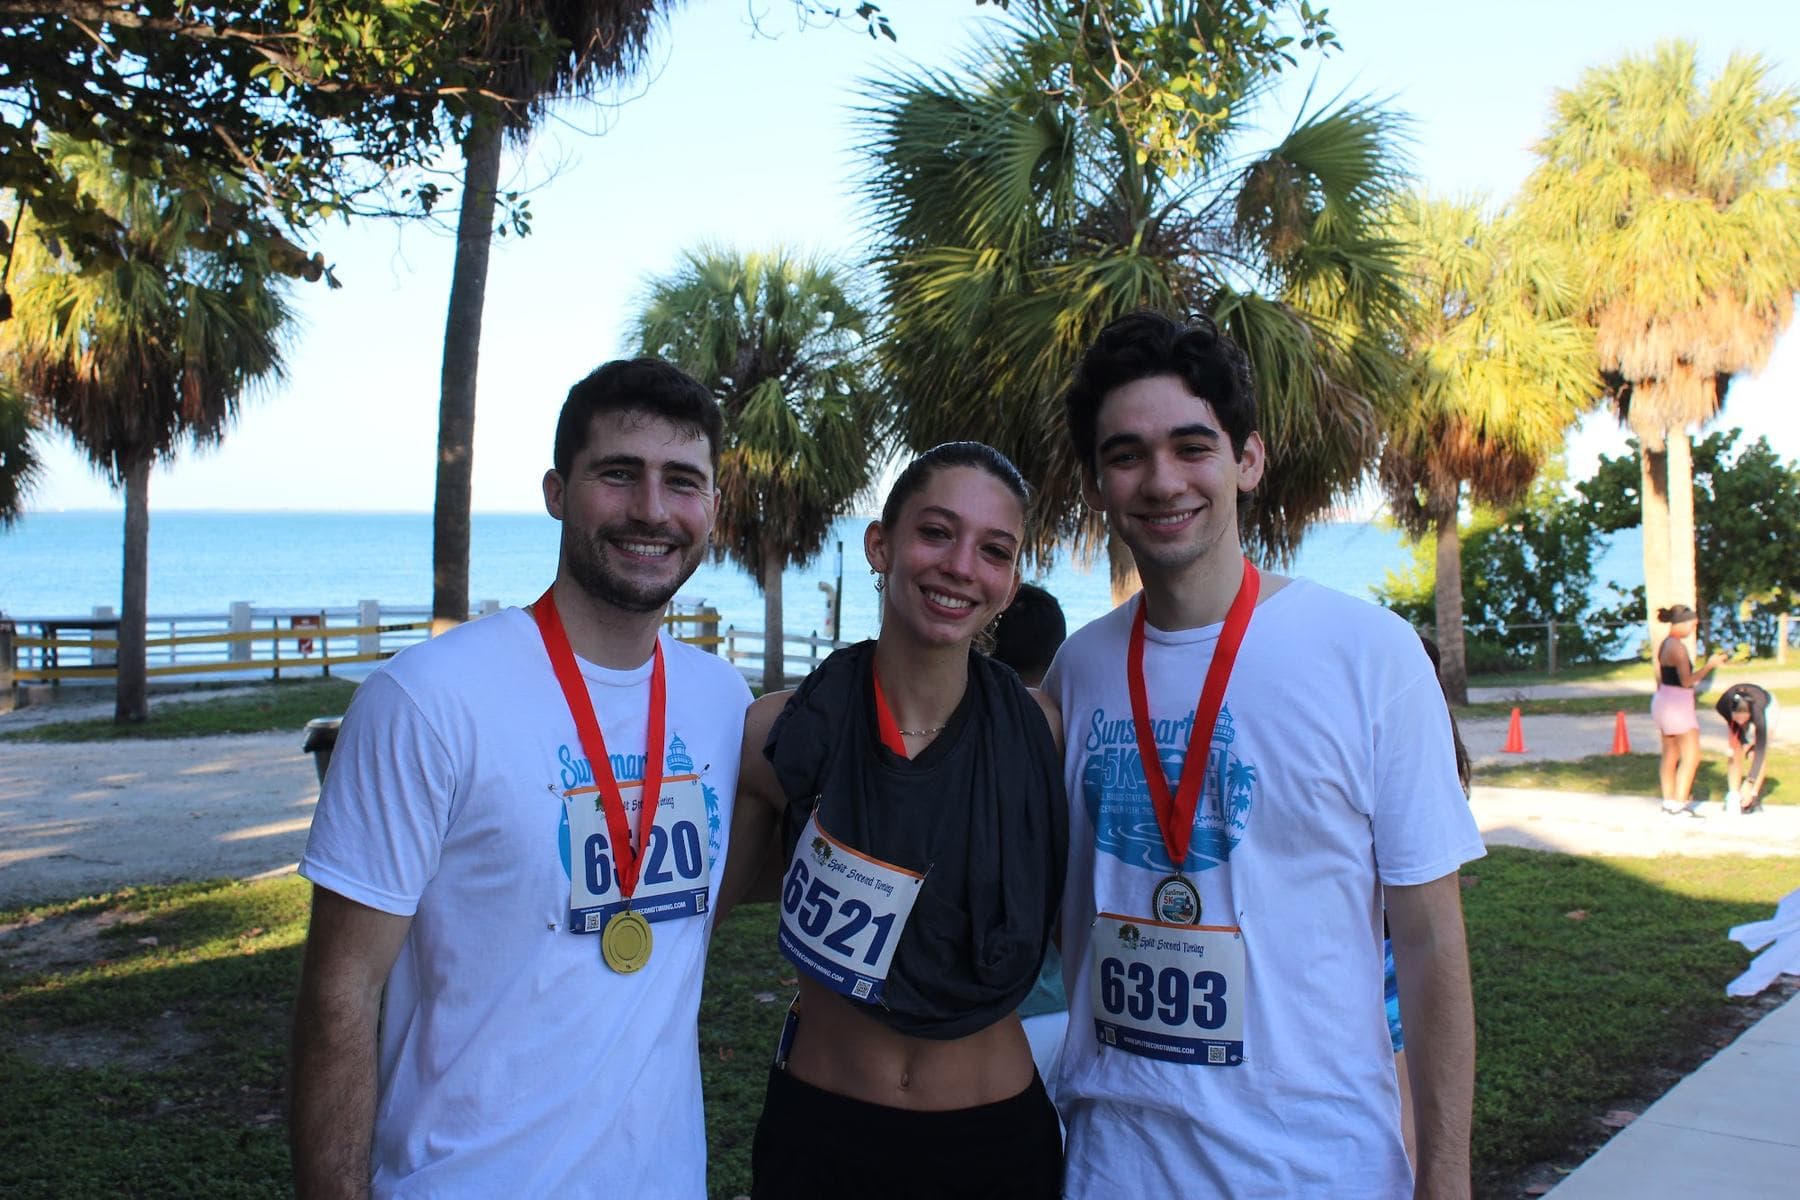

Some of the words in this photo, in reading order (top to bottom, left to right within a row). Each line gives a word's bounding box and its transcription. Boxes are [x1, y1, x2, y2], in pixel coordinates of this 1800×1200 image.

[1086, 708, 1195, 751] Sunsart
[1101, 747, 1138, 790] 5K
[827, 858, 848, 874] Split
[874, 878, 895, 898] Timing
[783, 858, 897, 967] 6521
[1139, 936, 1155, 951] Split
[1182, 942, 1205, 958] Timing
[1100, 956, 1228, 1030] 6393
